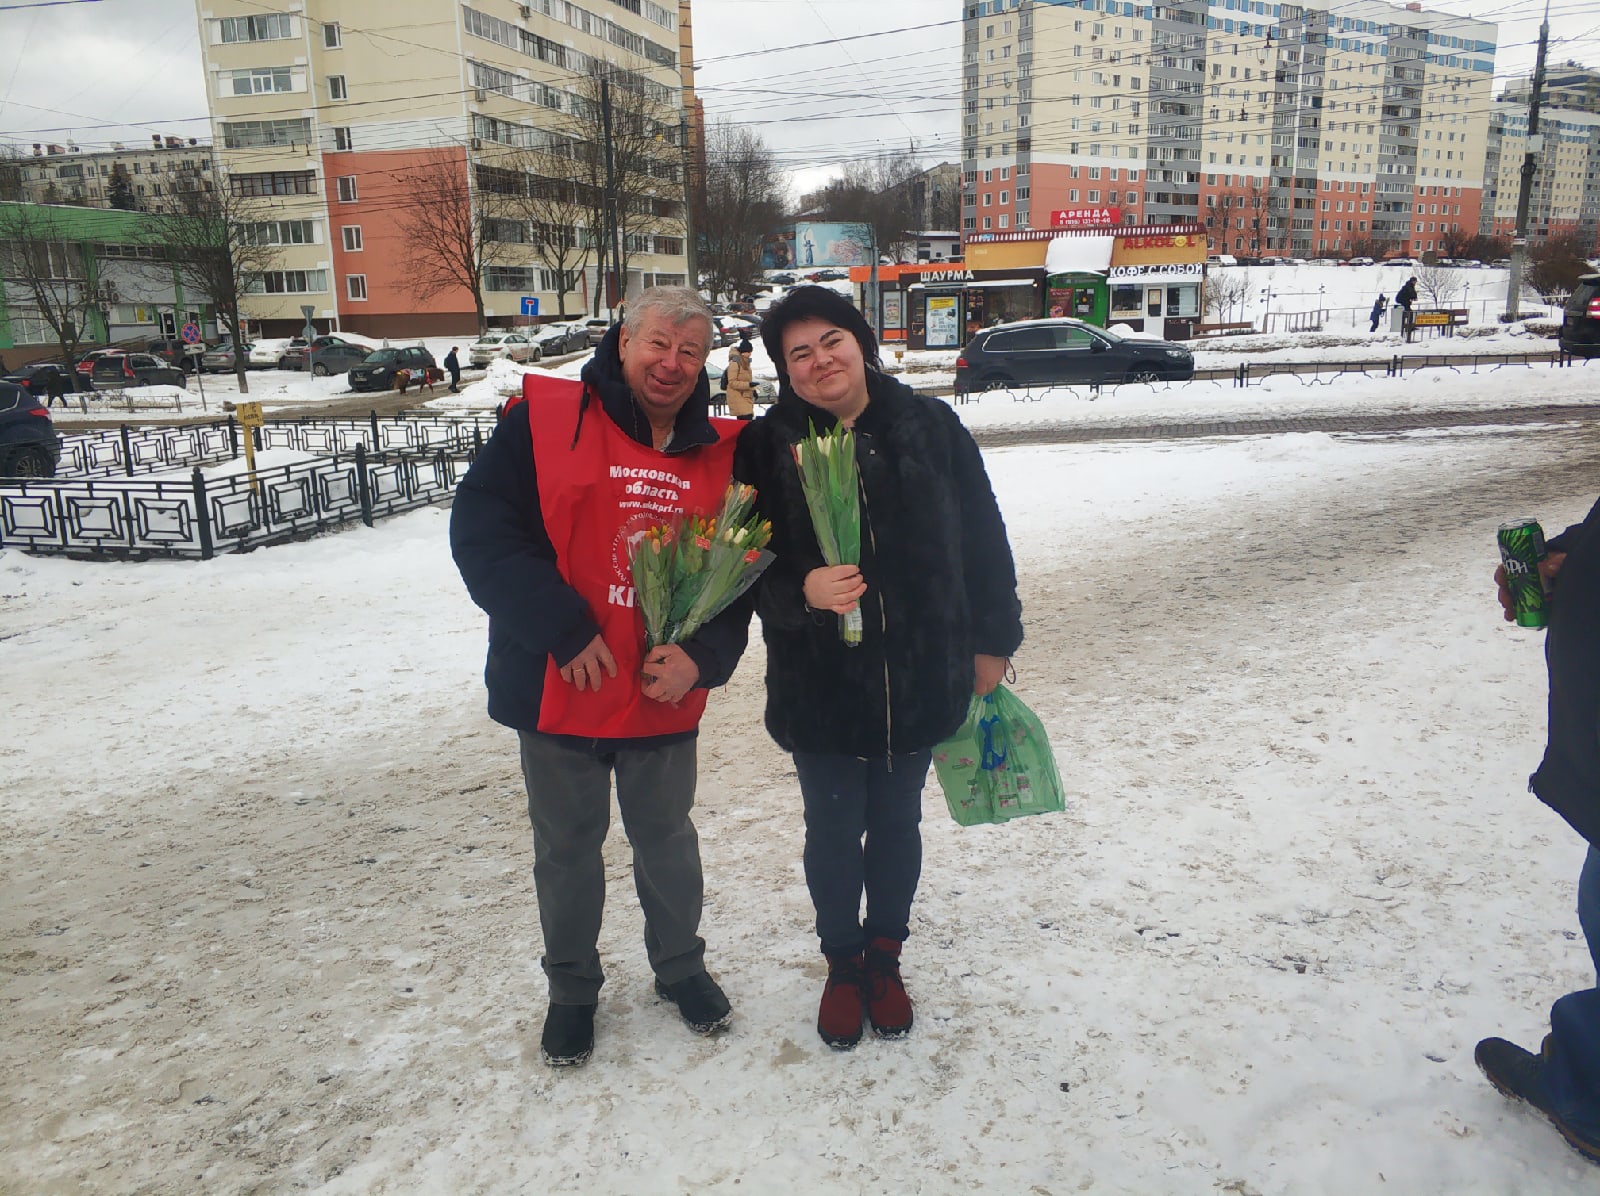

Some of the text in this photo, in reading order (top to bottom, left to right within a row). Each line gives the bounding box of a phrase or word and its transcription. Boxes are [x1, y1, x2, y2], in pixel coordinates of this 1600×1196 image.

[1060, 209, 1110, 218] АРЕНДА
[920, 270, 975, 282] ШАУРМА
[1109, 261, 1203, 278] КОФЕ С СОБОЙ
[609, 465, 691, 490] Московская
[625, 480, 679, 500] область
